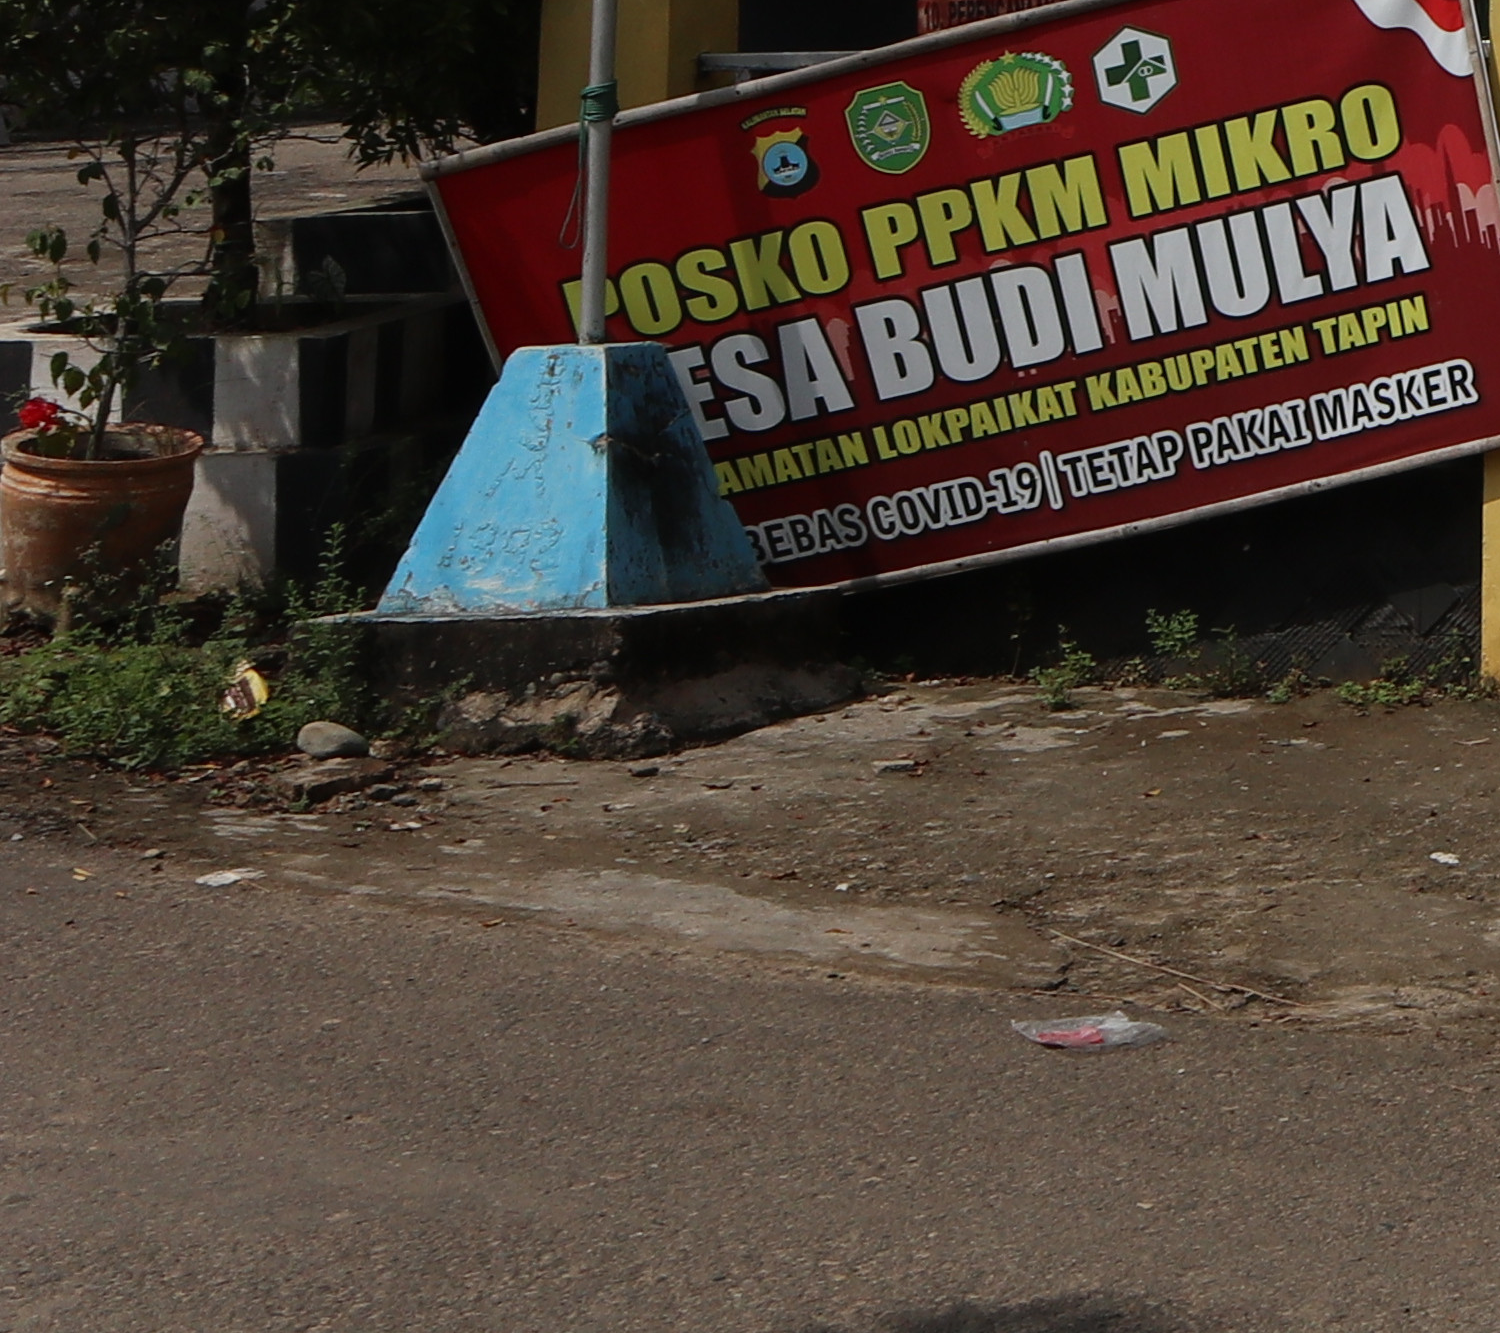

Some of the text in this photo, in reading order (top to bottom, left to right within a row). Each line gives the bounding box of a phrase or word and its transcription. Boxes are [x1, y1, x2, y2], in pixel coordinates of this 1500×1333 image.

[562, 83, 1401, 337] POSKO PPKM MIKRO
[668, 317, 856, 443] ESA
[855, 252, 1104, 402] BUDI
[1109, 174, 1431, 342] MULYA
[714, 295, 1430, 497] AMATAN LOKPAIKAT KABUPATEN TAPIN
[1063, 435, 1179, 489] TETAP
[1191, 405, 1309, 462] PAKAI
[1315, 364, 1474, 435] MASKER
